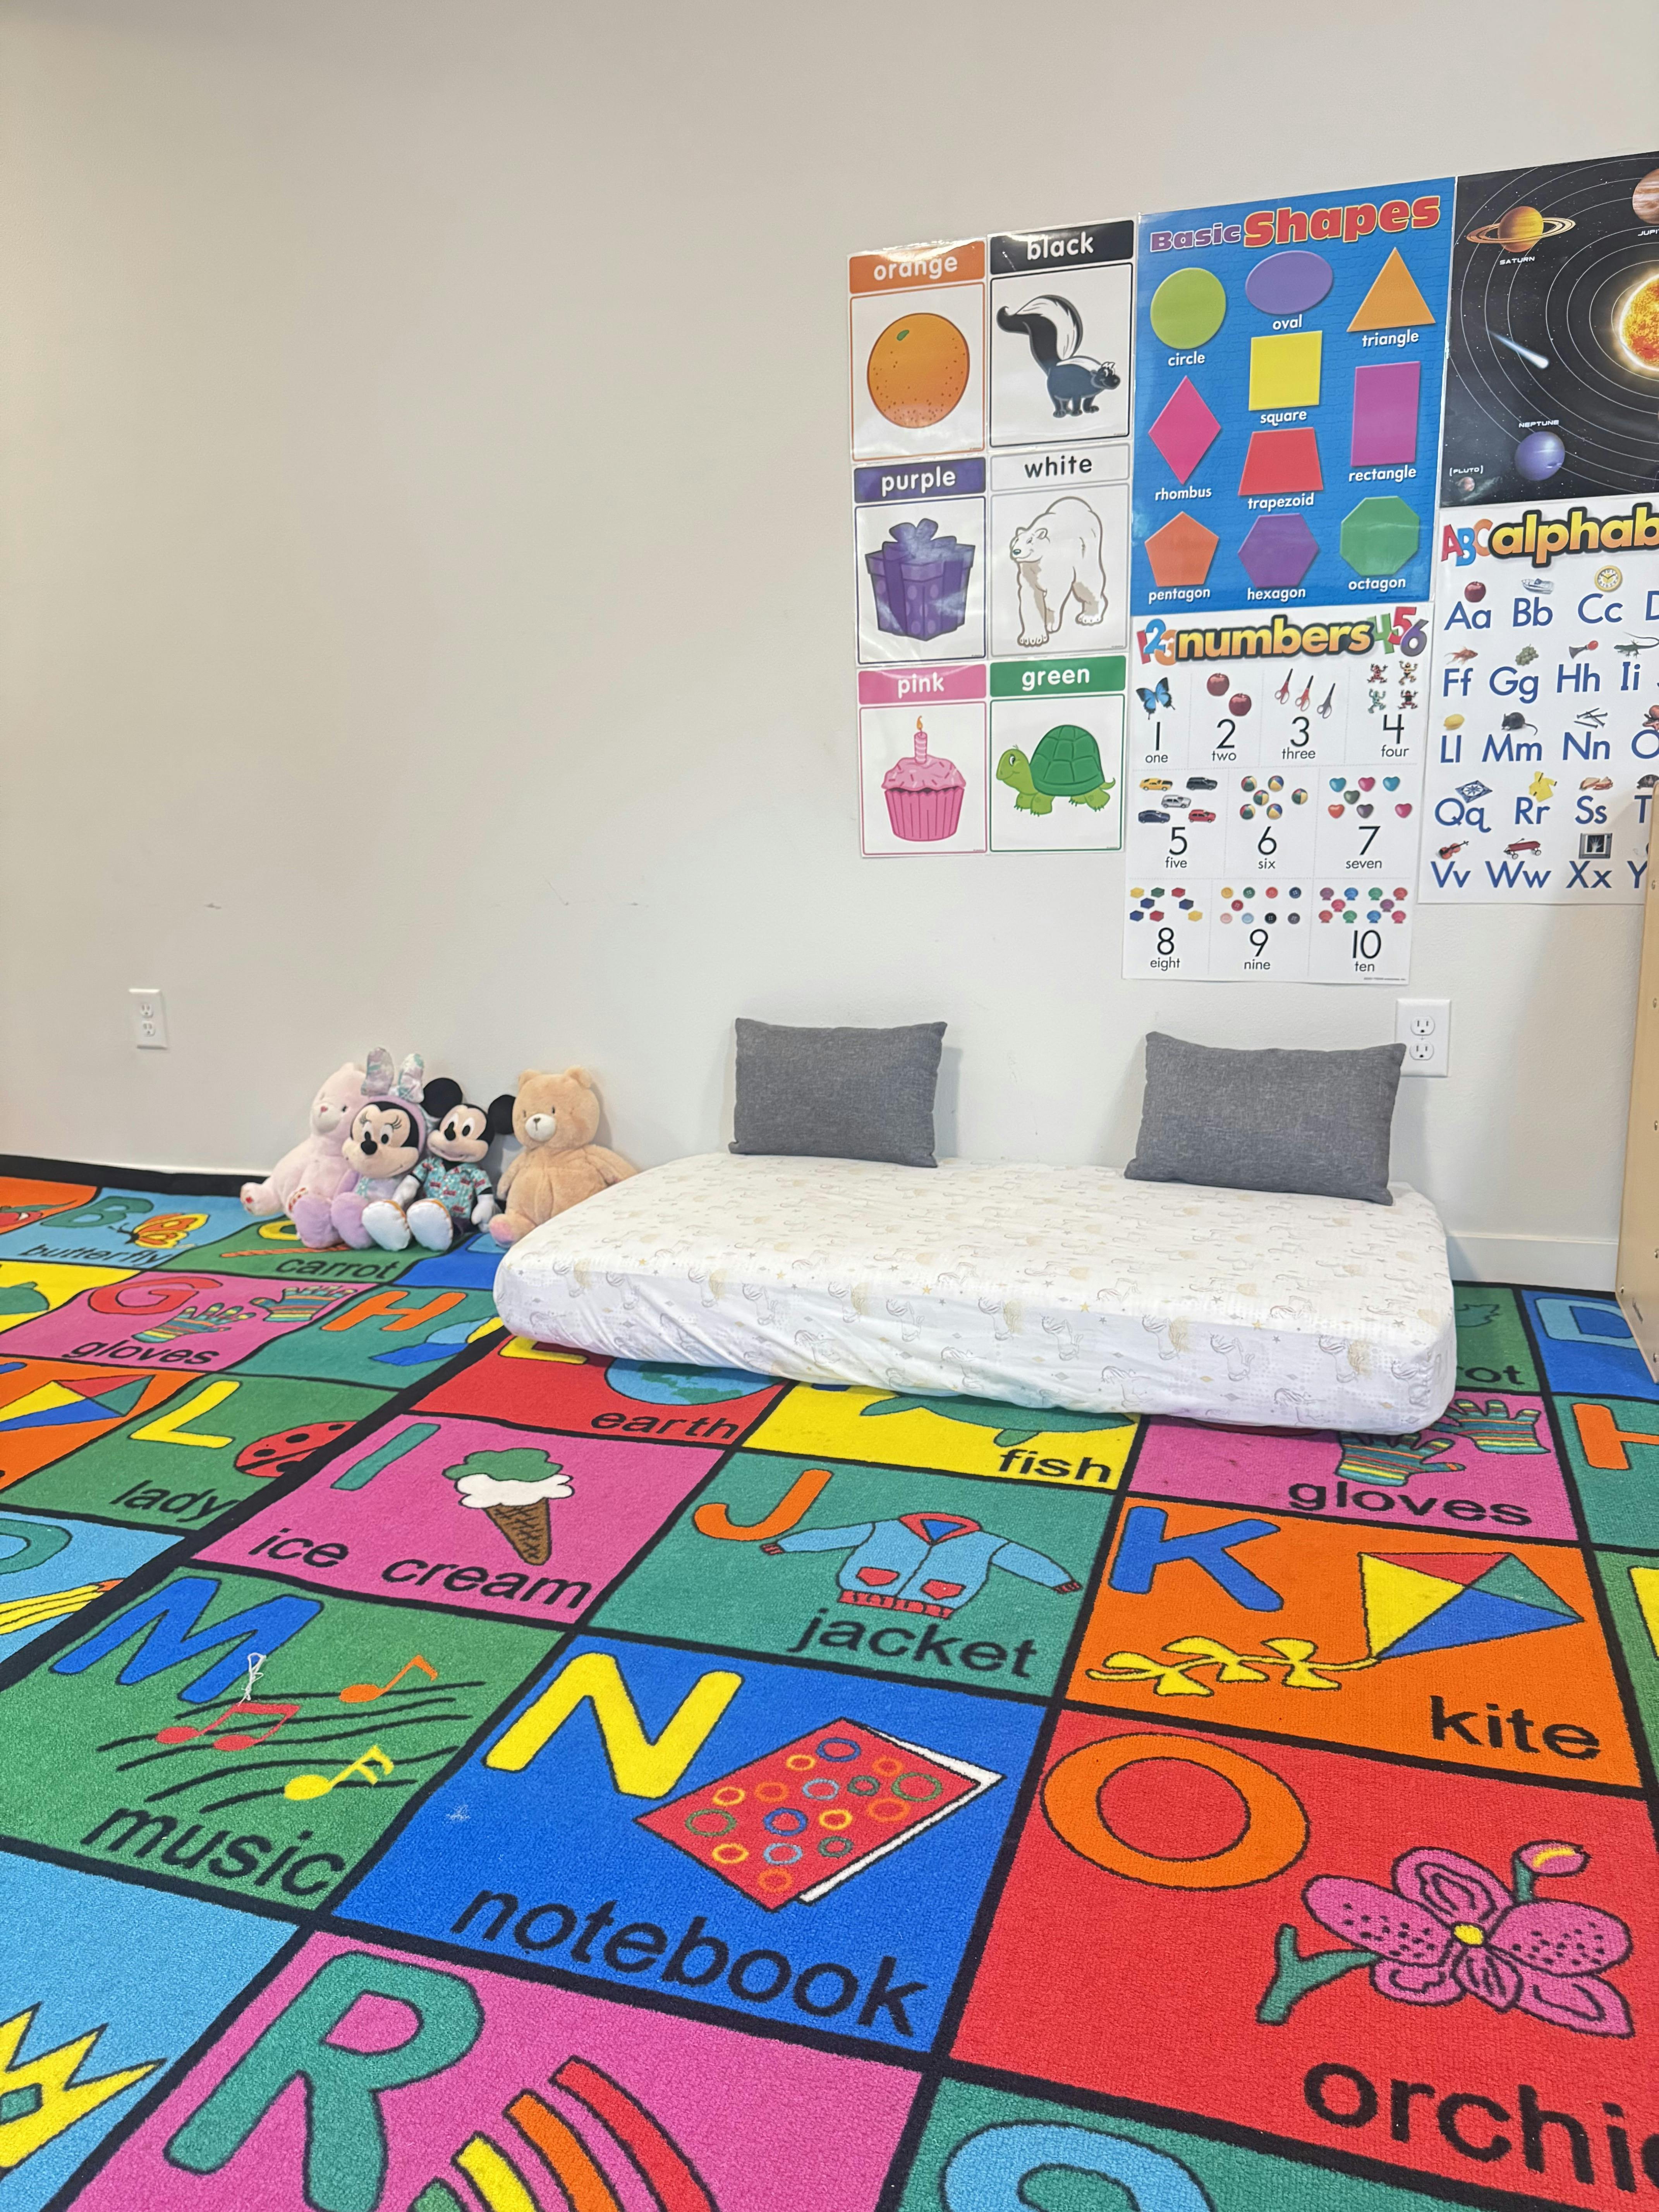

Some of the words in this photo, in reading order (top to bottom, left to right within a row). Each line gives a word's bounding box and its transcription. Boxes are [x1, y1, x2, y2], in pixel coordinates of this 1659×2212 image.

[1150, 222, 1242, 252] Basic
[1243, 196, 1441, 248] Shapes
[1027, 232, 1094, 261] black
[1499, 256, 1535, 265] SATURN
[874, 256, 958, 280] orange
[1272, 314, 1303, 330] oval
[1362, 329, 1419, 349] triangle
[1168, 352, 1205, 367] circle
[1260, 410, 1307, 427] square
[1518, 420, 1559, 428] NEPTUNE
[881, 466, 955, 496] purple
[1025, 455, 1092, 479] white
[1348, 465, 1417, 483] rectangle
[1449, 465, 1484, 476] (PLUTO)
[1155, 486, 1212, 501] rhombus
[1247, 493, 1314, 512] trapezoid
[1148, 587, 1211, 605] pentagon
[1247, 587, 1306, 603] hexagon
[1348, 577, 1406, 593] octagon
[1444, 601, 1491, 630] Aa
[1513, 597, 1553, 627] Bb
[1578, 593, 1623, 624] Cc
[1176, 615, 1374, 661] numbers
[898, 671, 945, 698] pink
[1022, 666, 1090, 693] green
[1443, 667, 1473, 697] Ff
[1489, 666, 1539, 704] Gg
[1557, 663, 1600, 693] Hh
[1621, 661, 1640, 690] Ii
[1155, 721, 1160, 751] 1
[1217, 719, 1236, 749] 2
[1290, 716, 1309, 747] 3
[1383, 714, 1404, 744] 4
[1145, 752, 1168, 764] one
[1211, 750, 1237, 761] two
[1282, 748, 1316, 759] three
[1381, 745, 1409, 758] four
[1440, 735, 1462, 763] Ll
[1482, 734, 1542, 762] Mm
[1563, 731, 1610, 761] Nn
[1434, 797, 1491, 833] Qq
[1515, 797, 1551, 824] Rr
[1575, 795, 1607, 824] Ss
[1169, 826, 1187, 855] 5
[1257, 826, 1277, 855] 6
[1358, 826, 1381, 855] 7
[1165, 857, 1187, 869] five
[1258, 859, 1276, 869] six
[1345, 859, 1382, 869] seven
[1430, 861, 1471, 888] Vv
[1485, 861, 1552, 888] Ww
[1566, 860, 1612, 888] Xx
[1157, 927, 1175, 955] 8
[1250, 929, 1269, 957] 9
[1352, 929, 1381, 959] 10
[1150, 958, 1180, 971] eight
[1244, 959, 1271, 970] nine
[1355, 961, 1375, 972] ten
[40, 1196, 154, 1228] B
[18, 1243, 173, 1267] butterfly
[276, 1259, 400, 1279] carrot
[87, 1277, 223, 1315] G
[321, 1290, 467, 1331] H
[62, 1339, 219, 1369] gloves
[129, 1380, 241, 1448] L
[591, 1411, 739, 1440] earth
[998, 1449, 1112, 1484] fish
[110, 1480, 240, 1524] lady
[693, 1468, 834, 1542] J
[1288, 1480, 1533, 1527] gloves
[249, 1528, 350, 1568] ice
[381, 1558, 592, 1608] cream
[1108, 1506, 1285, 1613] K
[50, 1577, 324, 1704] M
[787, 1608, 1038, 1678] jacket
[482, 1652, 745, 1799] N
[1430, 1695, 1602, 1761] kite
[1039, 1732, 1310, 1892] O
[79, 1807, 346, 1896] music
[450, 1890, 929, 2037] notebook
[163, 1949, 486, 2212] R
